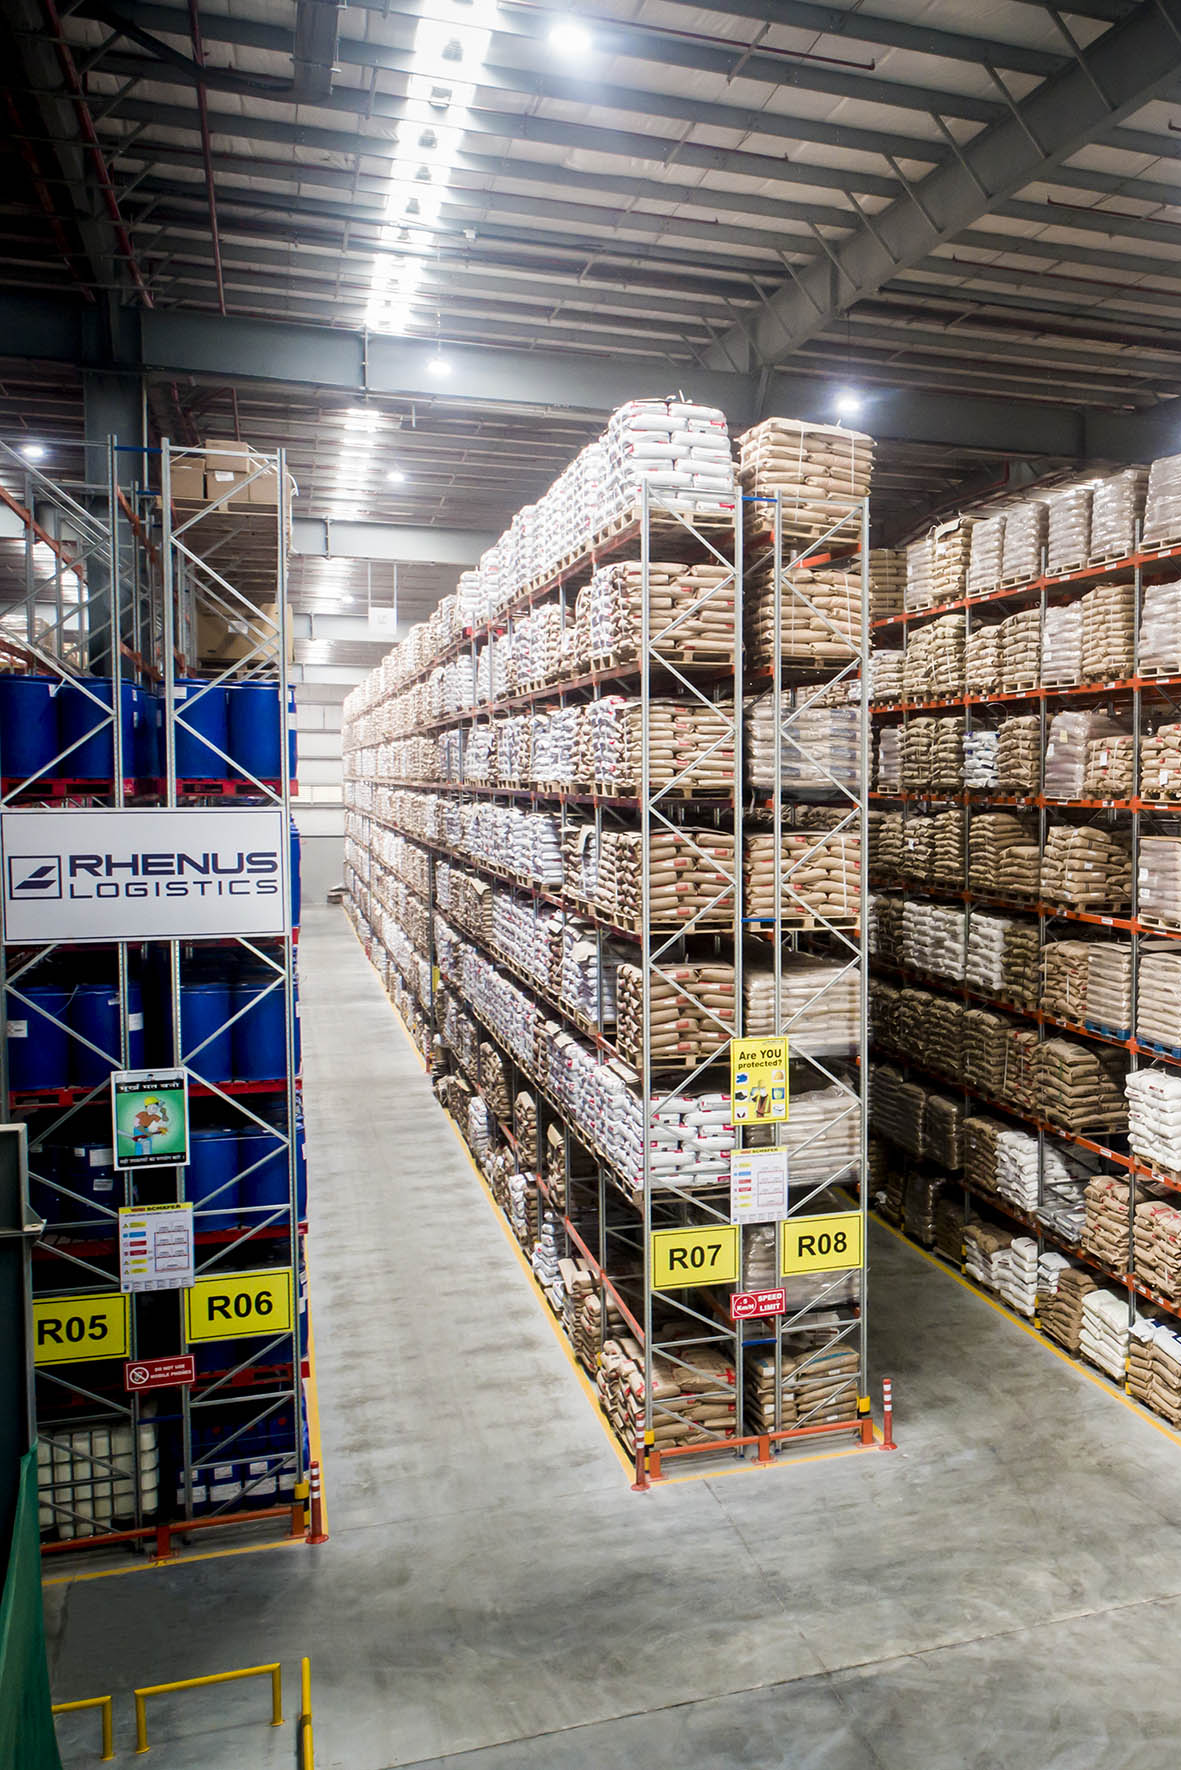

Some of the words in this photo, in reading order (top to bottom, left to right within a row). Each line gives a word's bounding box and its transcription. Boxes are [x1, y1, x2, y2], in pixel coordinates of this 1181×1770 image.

[69, 852, 278, 877] RHENUS
[70, 879, 278, 898] LOGISTICS
[738, 1060, 783, 1070] protected?
[739, 1051, 757, 1060] Are
[760, 1049, 782, 1059] YOU
[798, 1231, 848, 1258] R08
[669, 1244, 722, 1271] R07
[208, 1290, 273, 1321] R06
[758, 1293, 783, 1302] SPEED
[760, 1303, 781, 1311] LIMIT
[37, 1314, 108, 1345] R05
